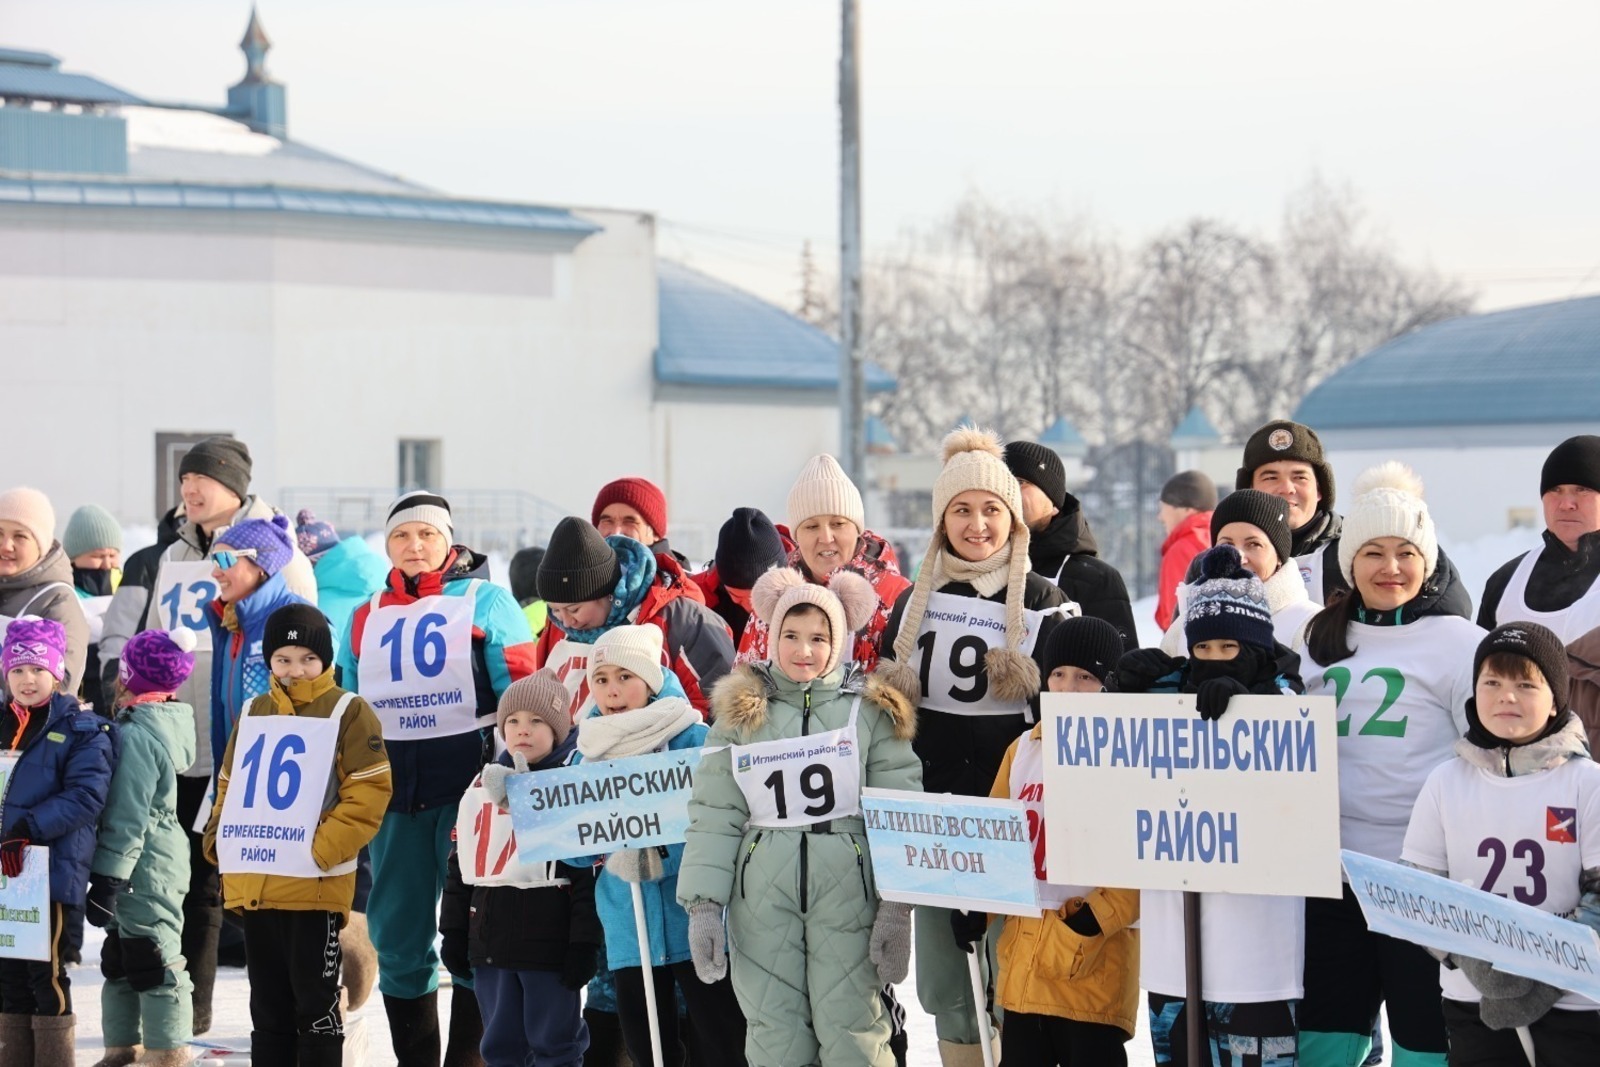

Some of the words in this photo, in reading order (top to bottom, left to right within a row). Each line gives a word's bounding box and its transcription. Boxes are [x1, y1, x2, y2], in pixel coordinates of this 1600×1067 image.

[160, 580, 217, 632] 13
[923, 609, 968, 624] линский
[968, 616, 1007, 634] район
[380, 612, 448, 683] 16
[916, 630, 989, 703] 19
[372, 688, 463, 709] ЕРМЕКЕЕВСКИЙ
[400, 713, 437, 730] РАЙОН
[1322, 666, 1409, 738] 22
[752, 748, 805, 765] Иглинский
[808, 745, 838, 759] район
[1056, 708, 1317, 779] КАРАИДЕЛЬСКИЙ
[240, 733, 306, 811] 16
[529, 760, 693, 812] ЗИЛАИРСКИЙ
[764, 763, 836, 819] 19
[222, 825, 306, 842] ЕРМЕКЕЕВСКИЙ
[577, 812, 662, 846] РАЙОН
[865, 809, 1026, 843] ИЛИШЕВСКИЙ
[1136, 798, 1239, 864] РАЙОН
[240, 845, 276, 863] РАЙОН
[904, 842, 986, 874] РАЙОН
[1477, 836, 1548, 907] 23
[0, 903, 40, 923] йский
[1364, 879, 1531, 953] КАРМАСКАЛИНСКИЙ
[1527, 931, 1594, 975] РАЙОН
